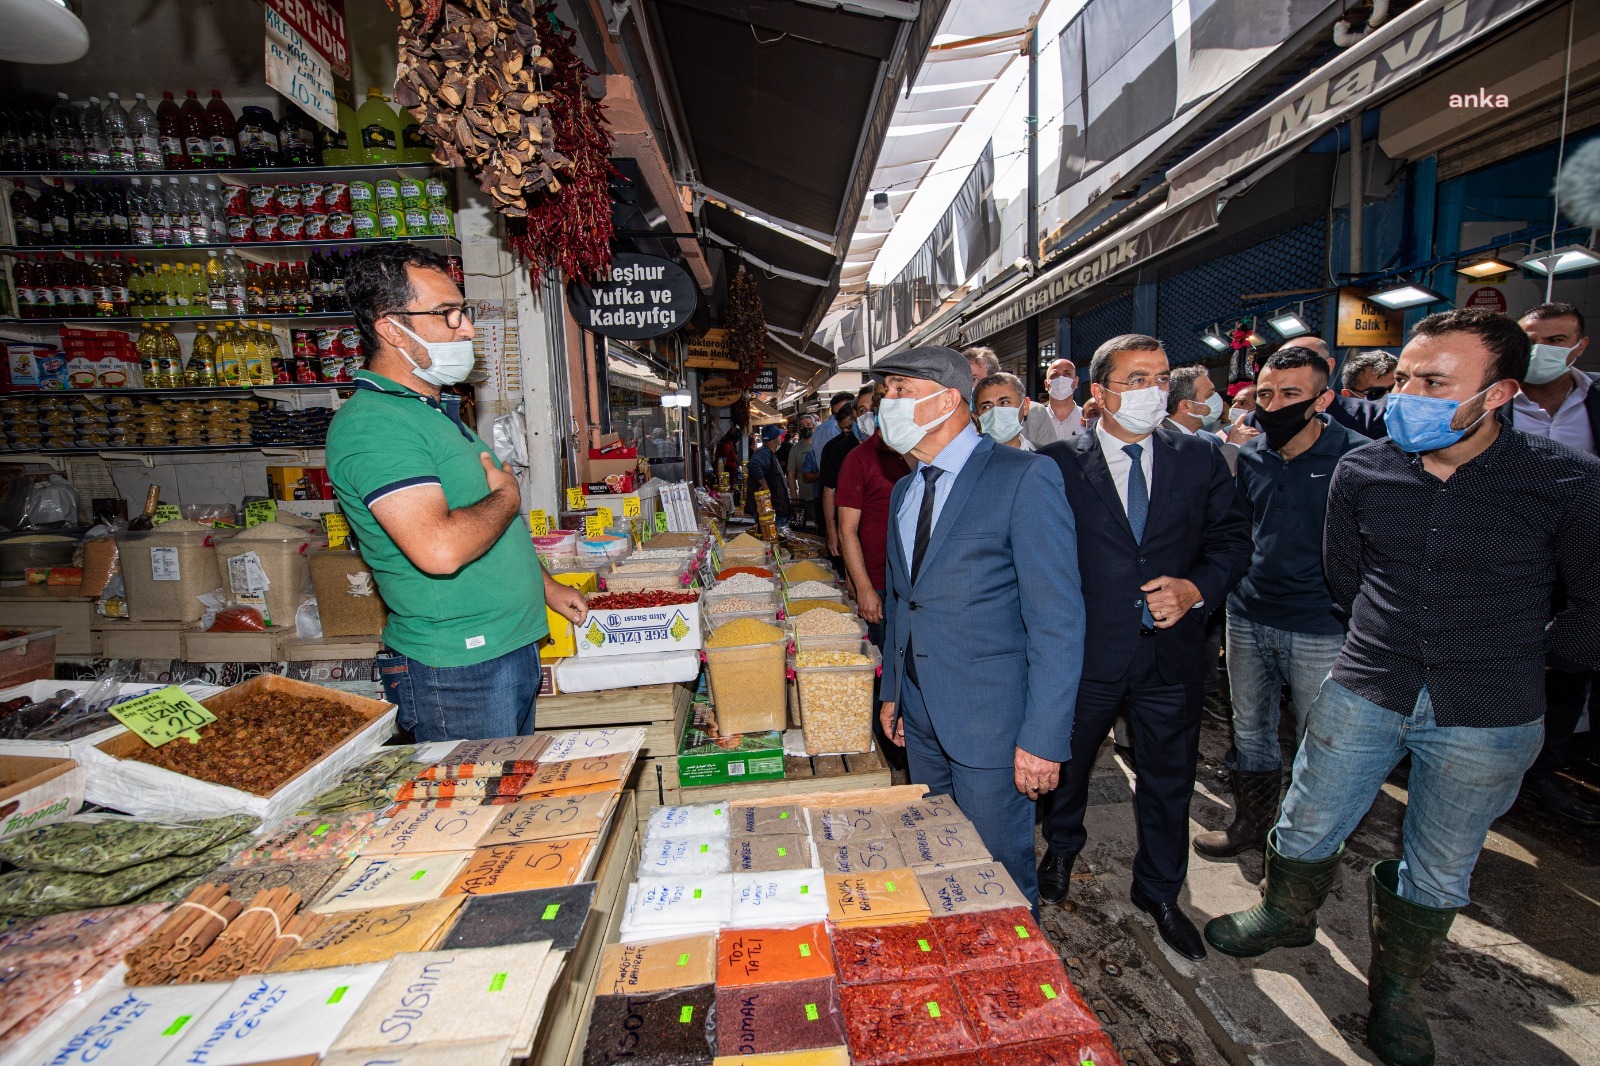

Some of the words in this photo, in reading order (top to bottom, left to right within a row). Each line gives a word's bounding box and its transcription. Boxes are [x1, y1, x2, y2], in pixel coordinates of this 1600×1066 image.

[1266, 0, 1469, 141] Mavi
[289, 75, 309, 105] 10
[1024, 239, 1137, 313] Balıkçılık
[592, 288, 645, 306] Yufka
[650, 289, 672, 304] ve
[590, 307, 676, 328] Kadayıfçı
[1355, 318, 1380, 331] Balık
[1383, 319, 1390, 331] 1
[688, 348, 707, 358] ahin
[609, 615, 619, 626] 10
[624, 614, 647, 622] Sarısı
[649, 613, 667, 621] Altın
[607, 631, 642, 645] ÜZÜM
[645, 629, 668, 640] EGE
[127, 671, 185, 682] MOCHA
[299, 667, 358, 680] MOCHA
[729, 937, 744, 966] TOZ
[746, 938, 763, 976] TATLI
[381, 956, 455, 1044] SUSAM
